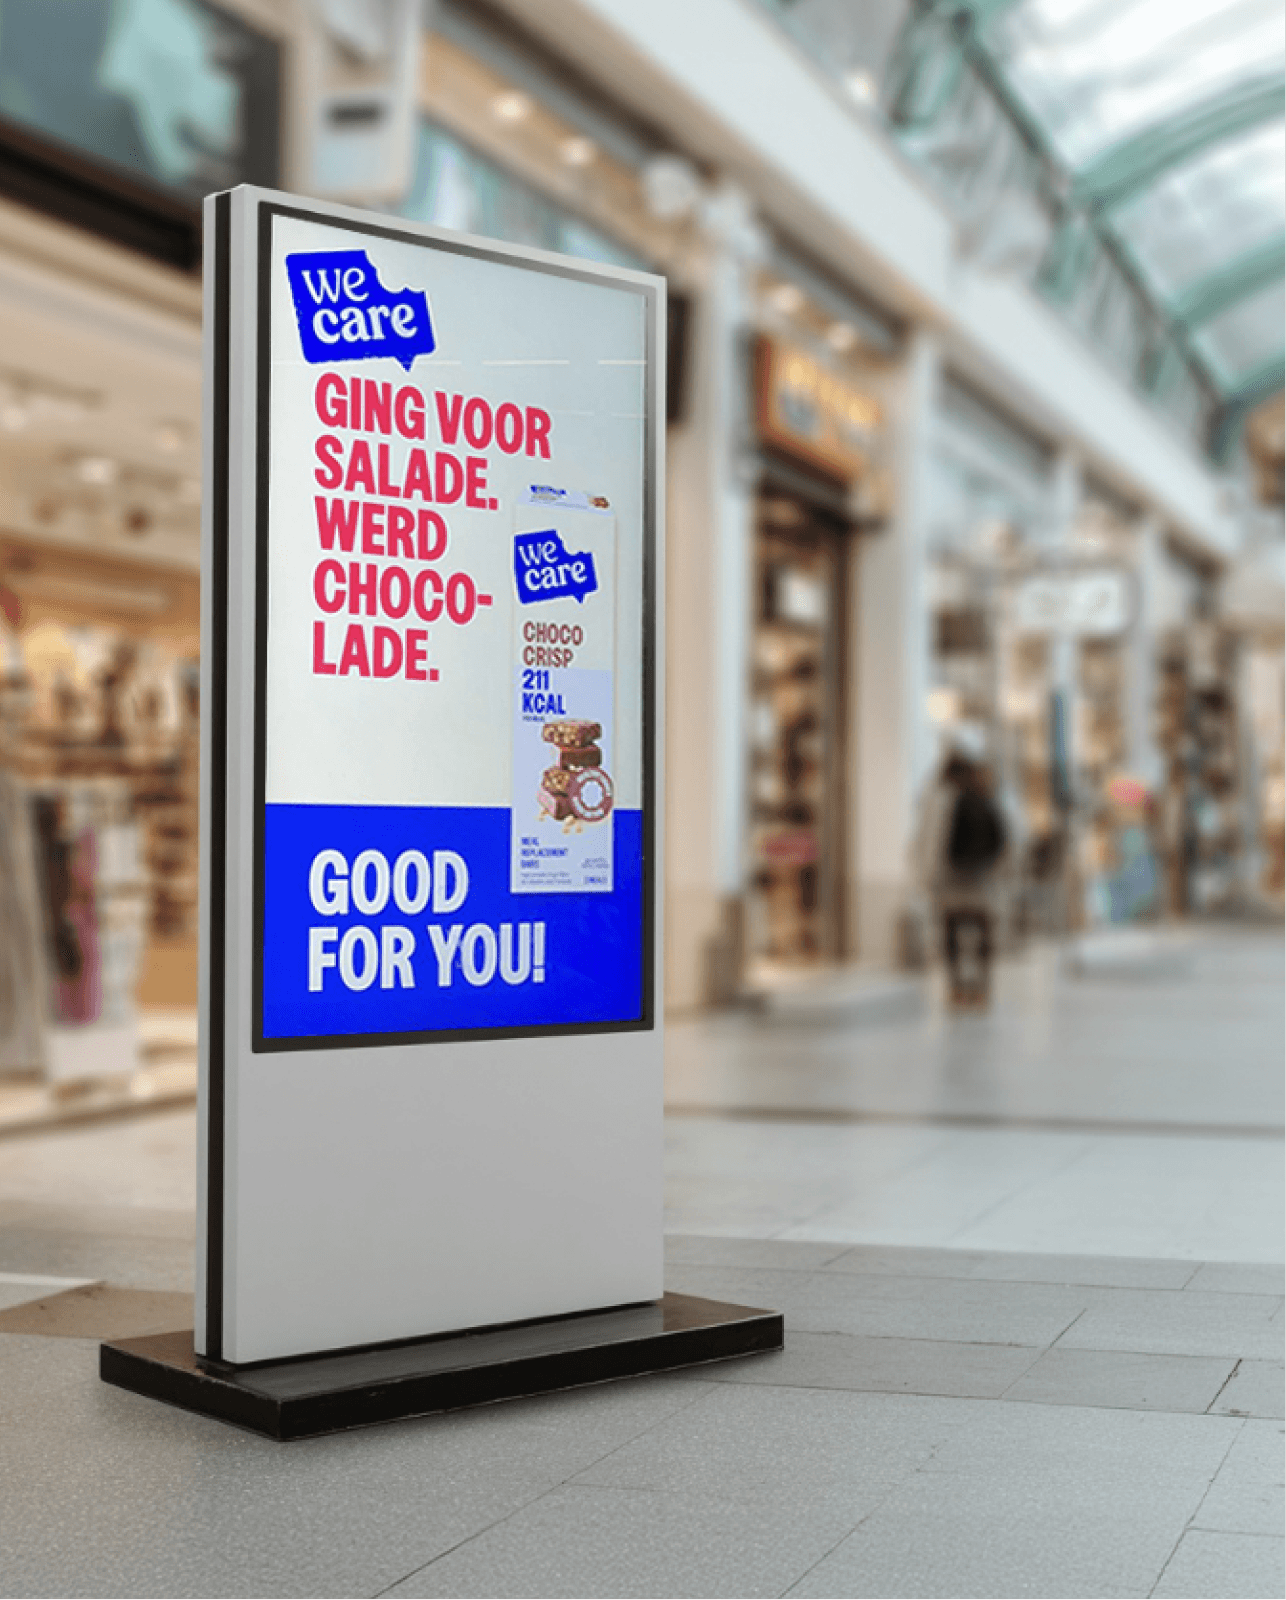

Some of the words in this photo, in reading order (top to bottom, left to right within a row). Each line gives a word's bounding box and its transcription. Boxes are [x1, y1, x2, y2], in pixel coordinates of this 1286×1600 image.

[301, 267, 370, 304] we
[312, 303, 418, 344] care
[314, 372, 426, 441] GING
[434, 390, 552, 459] VOOR
[314, 434, 499, 511] SALADE.
[314, 495, 448, 562] WERD
[518, 541, 558, 567] we
[313, 558, 494, 625] CHOCO-
[524, 560, 588, 592] care
[312, 620, 440, 682] LADE.
[522, 621, 584, 646] CHOCO
[522, 645, 574, 668] CRISP
[521, 669, 550, 691] 211
[521, 692, 567, 716] KCAL
[308, 848, 469, 916] GOOD
[308, 924, 416, 993] FOR
[427, 921, 547, 988] YOU!
